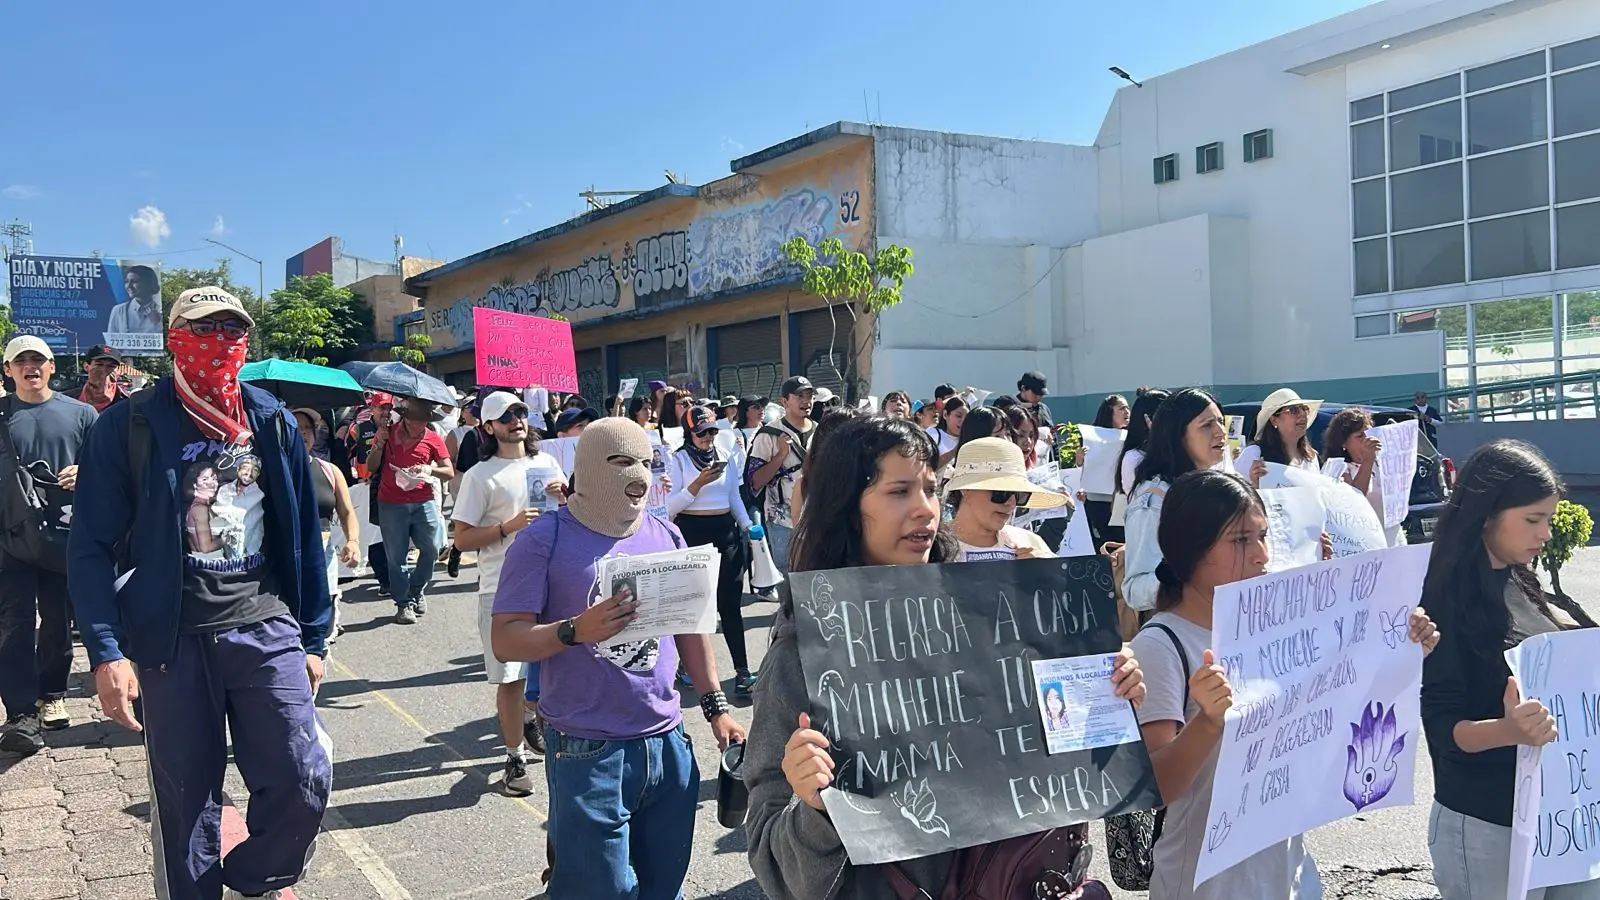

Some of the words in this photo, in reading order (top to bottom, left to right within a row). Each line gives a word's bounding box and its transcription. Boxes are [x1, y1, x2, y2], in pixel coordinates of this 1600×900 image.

[840, 190, 860, 224] 52
[12, 258, 37, 275] DÍA
[40, 260, 50, 276] Y
[54, 261, 101, 278] NOCHE
[13, 275, 66, 289] CUIDAMOS
[68, 278, 82, 289] DE
[84, 278, 93, 290] TI
[20, 289, 60, 298] URGENCIAS
[20, 308, 66, 318] FACILIDADES
[68, 310, 78, 318] DE
[80, 310, 97, 318] PAGO
[57, 300, 88, 308] HUMANA
[41, 325, 66, 336] Diego
[110, 339, 124, 347] 777
[126, 339, 140, 347] 330
[506, 345, 554, 360] NUESTRAS
[540, 371, 577, 390] LIBRES
[658, 563, 708, 573] LOCALIZARLA
[1235, 567, 1340, 640] MARCHAMOS
[1349, 557, 1383, 602] HOY
[841, 595, 972, 668] REGRESA
[994, 590, 1020, 644] A
[1033, 589, 1098, 636] CASA
[1258, 627, 1320, 681] MICHELLE
[1334, 616, 1344, 648] Y
[1081, 669, 1114, 680] LOCALIZA
[828, 669, 983, 742] MICHELLE,
[996, 648, 1035, 714] TÚ
[1232, 694, 1276, 742] TODAS
[1279, 682, 1302, 719] LAS
[1581, 690, 1600, 738] N
[856, 732, 964, 789] MAMÁ
[995, 723, 1038, 756] TE
[1241, 736, 1265, 777] NO
[1268, 706, 1334, 762] REGRESAN
[1236, 782, 1250, 818] A
[1260, 764, 1290, 806] CASA
[1567, 749, 1592, 795] DE
[1008, 766, 1124, 820] ESPERA
[1533, 800, 1600, 858] USCAR
